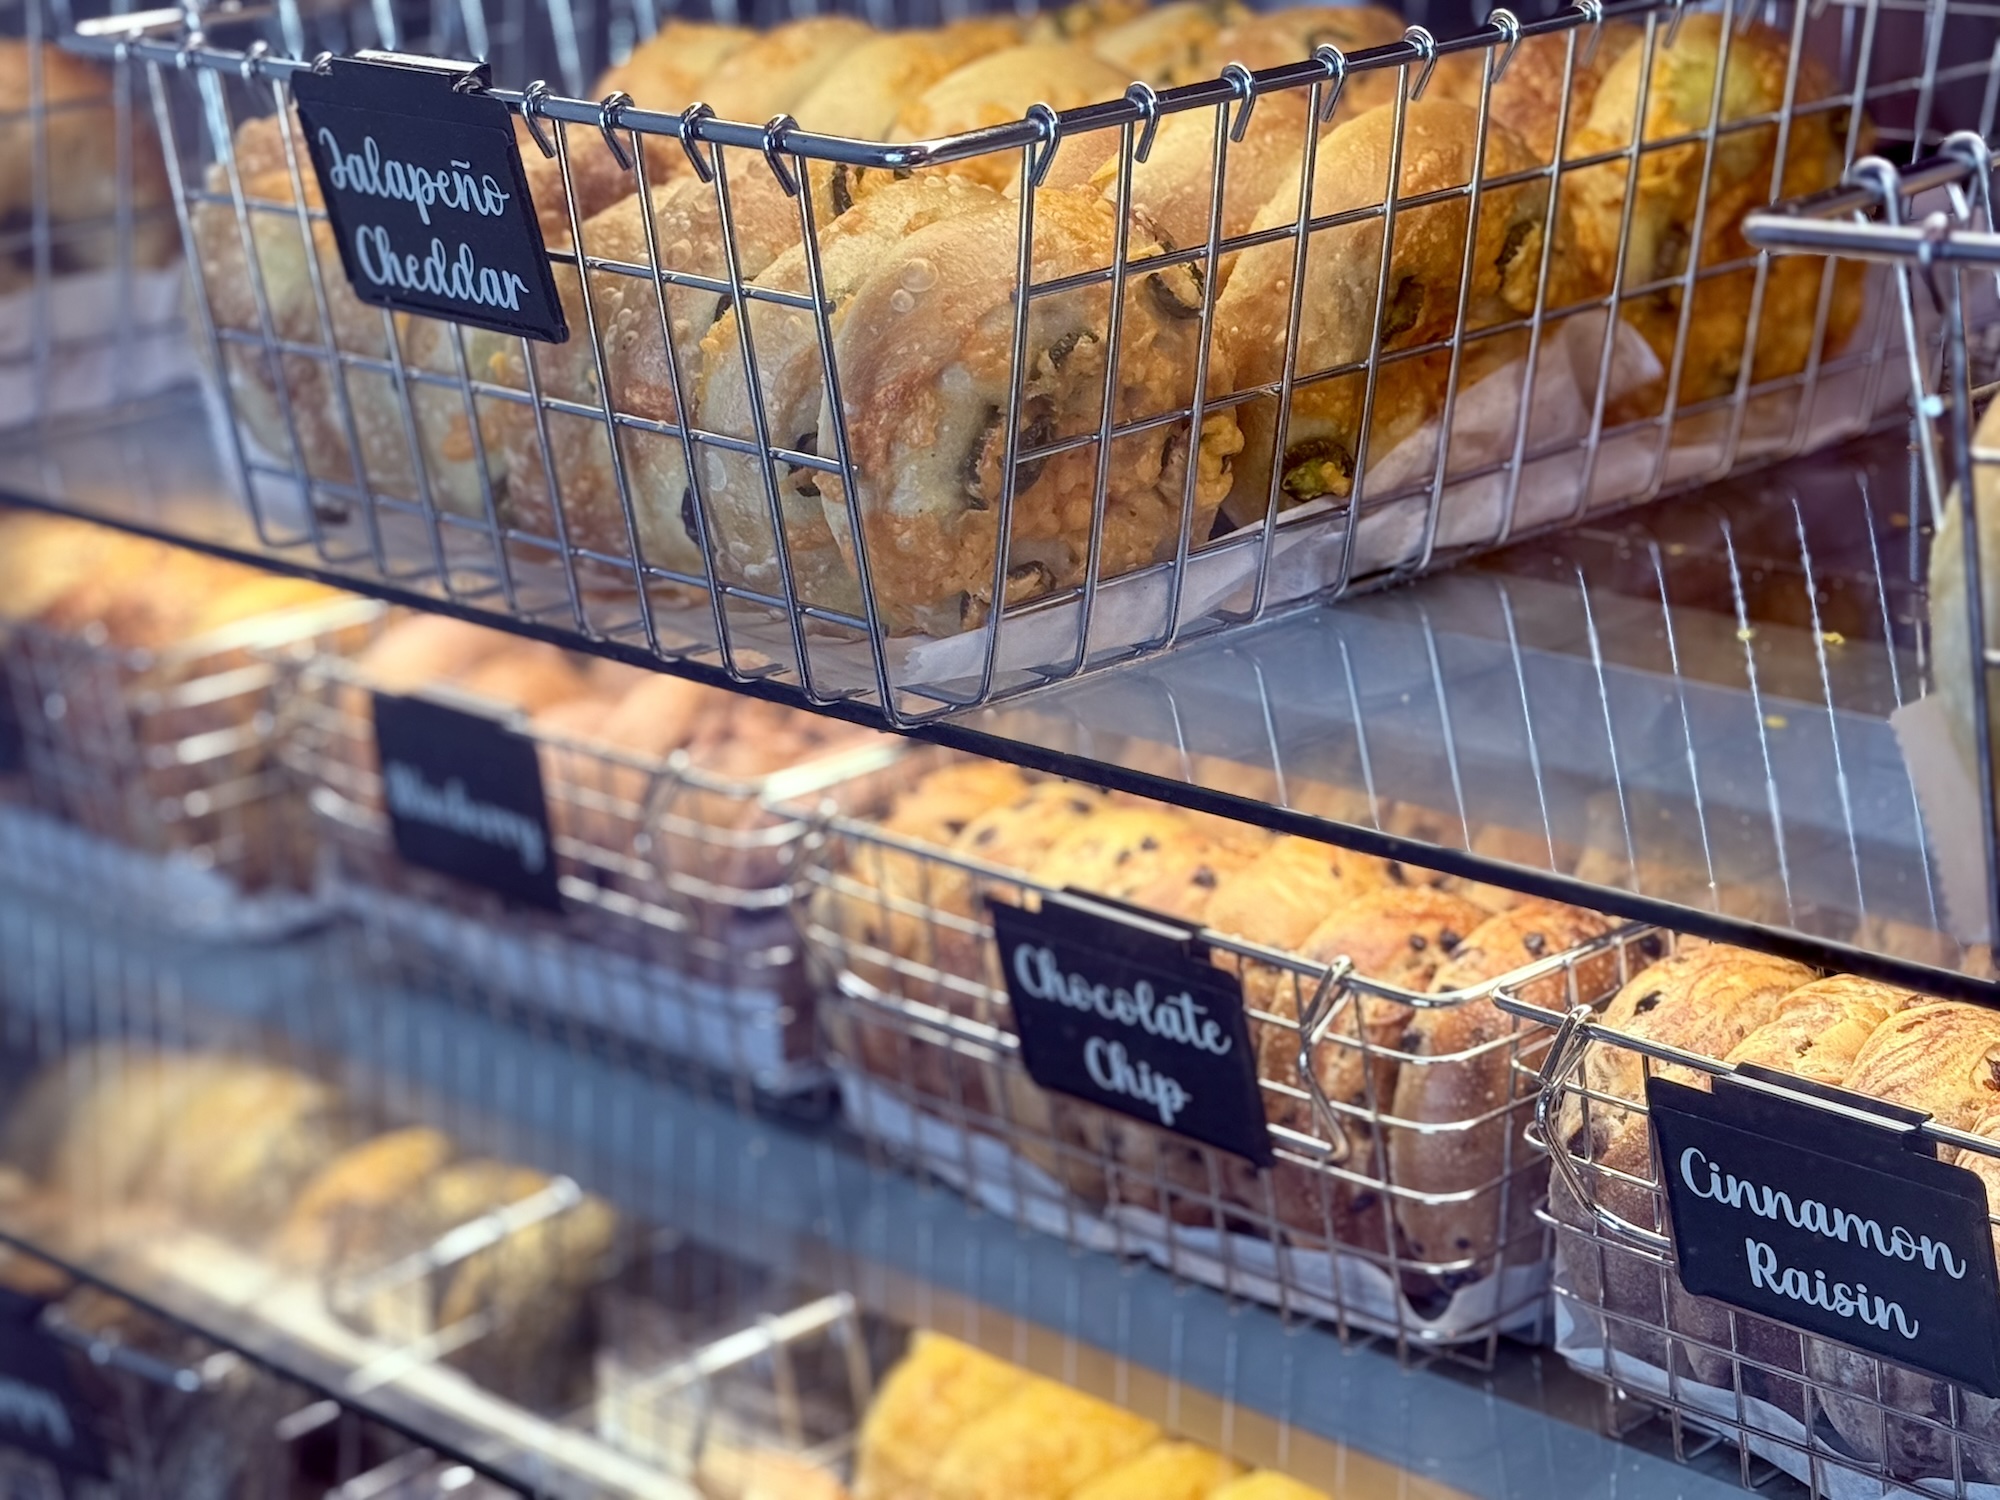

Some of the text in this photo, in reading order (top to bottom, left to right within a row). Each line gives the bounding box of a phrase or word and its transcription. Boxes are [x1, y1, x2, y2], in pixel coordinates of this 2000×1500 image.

[318, 127, 510, 225] Jalapeño
[356, 224, 530, 311] Cheddar
[1013, 943, 1232, 1055] Chocolate
[1083, 1036, 1192, 1126] Chip
[1680, 1147, 1967, 1280] Cinnamon
[1745, 1237, 1919, 1339] Raisin
